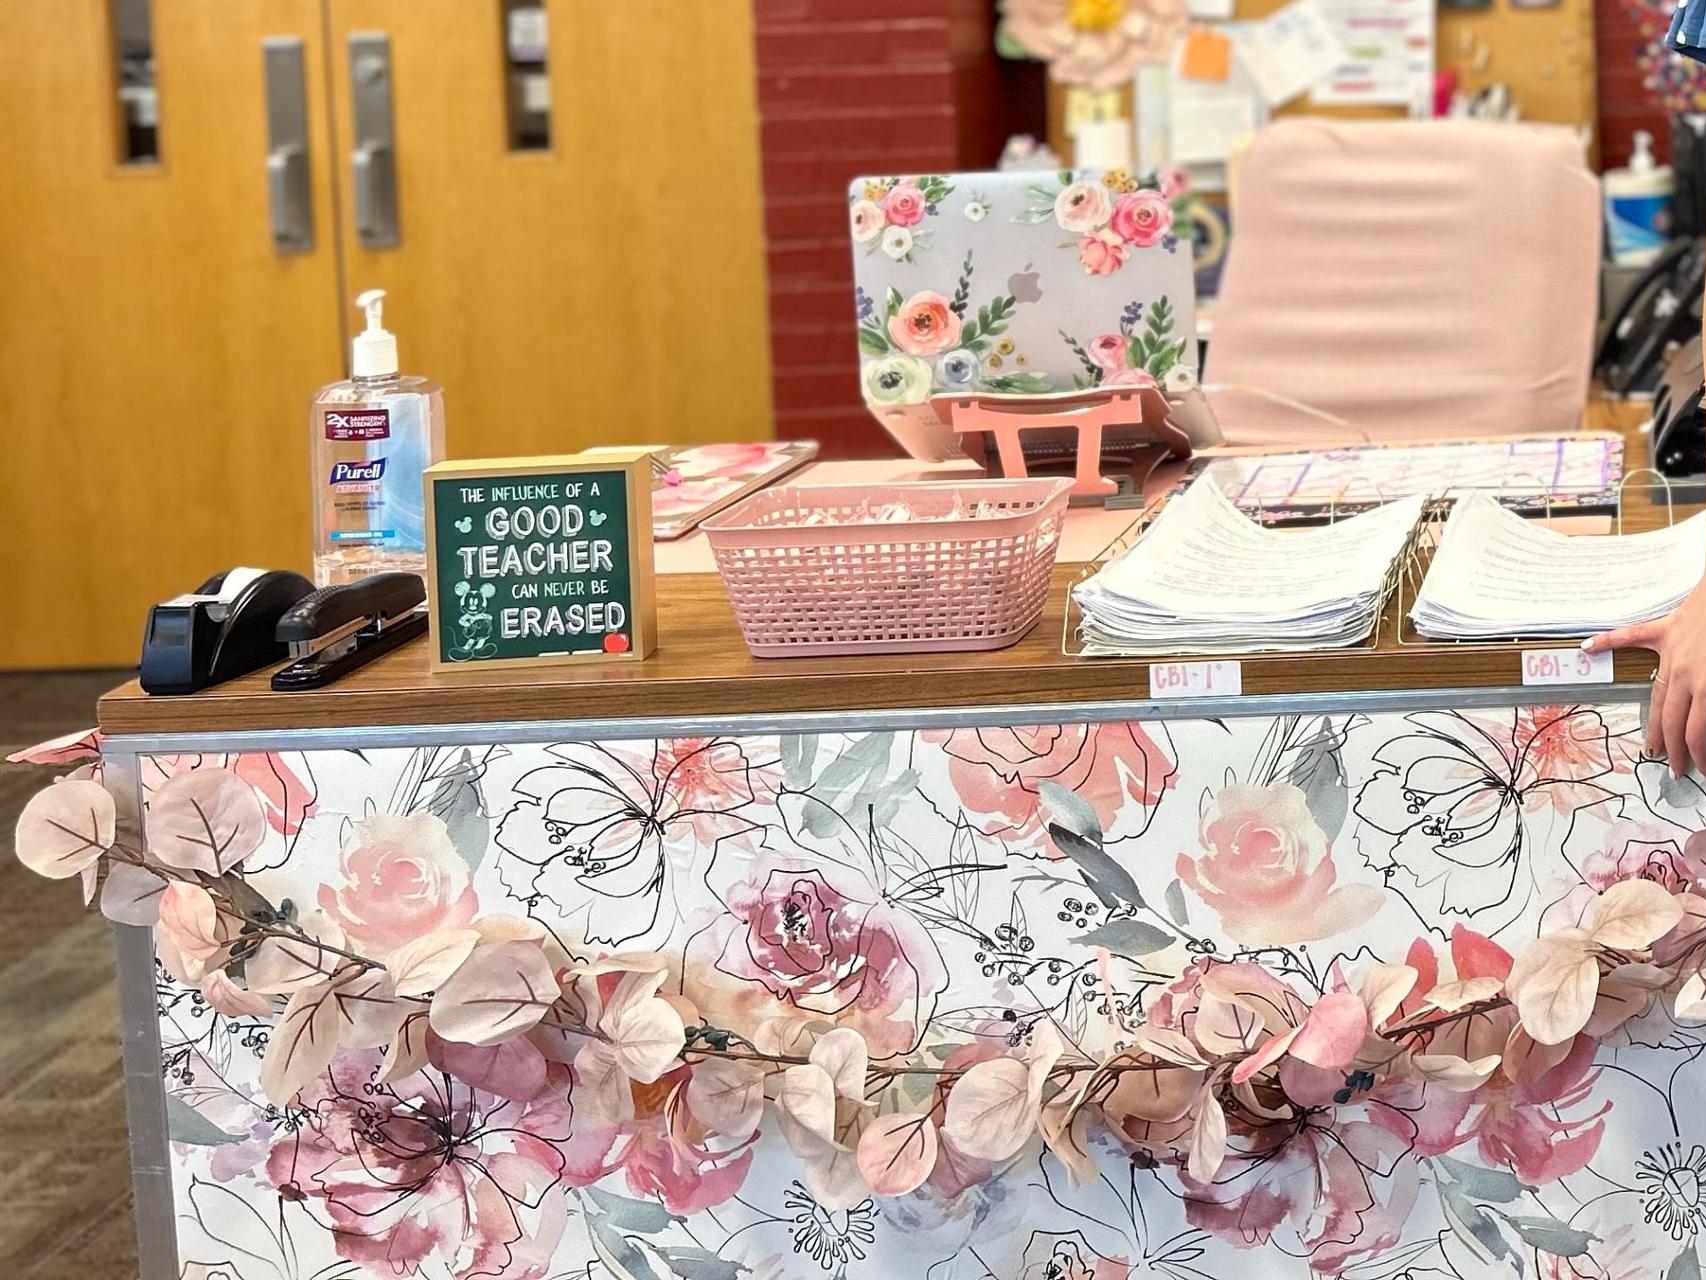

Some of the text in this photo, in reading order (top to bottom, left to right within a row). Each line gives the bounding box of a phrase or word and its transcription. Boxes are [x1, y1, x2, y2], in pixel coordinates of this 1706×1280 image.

[336, 463, 381, 480] Purell
[460, 482, 601, 503] THE INFLUENCE OF A
[485, 504, 584, 540] GOOD
[456, 540, 614, 578] TEACHER
[511, 579, 609, 599] CAN NEVER BE
[500, 601, 626, 639] ERASED
